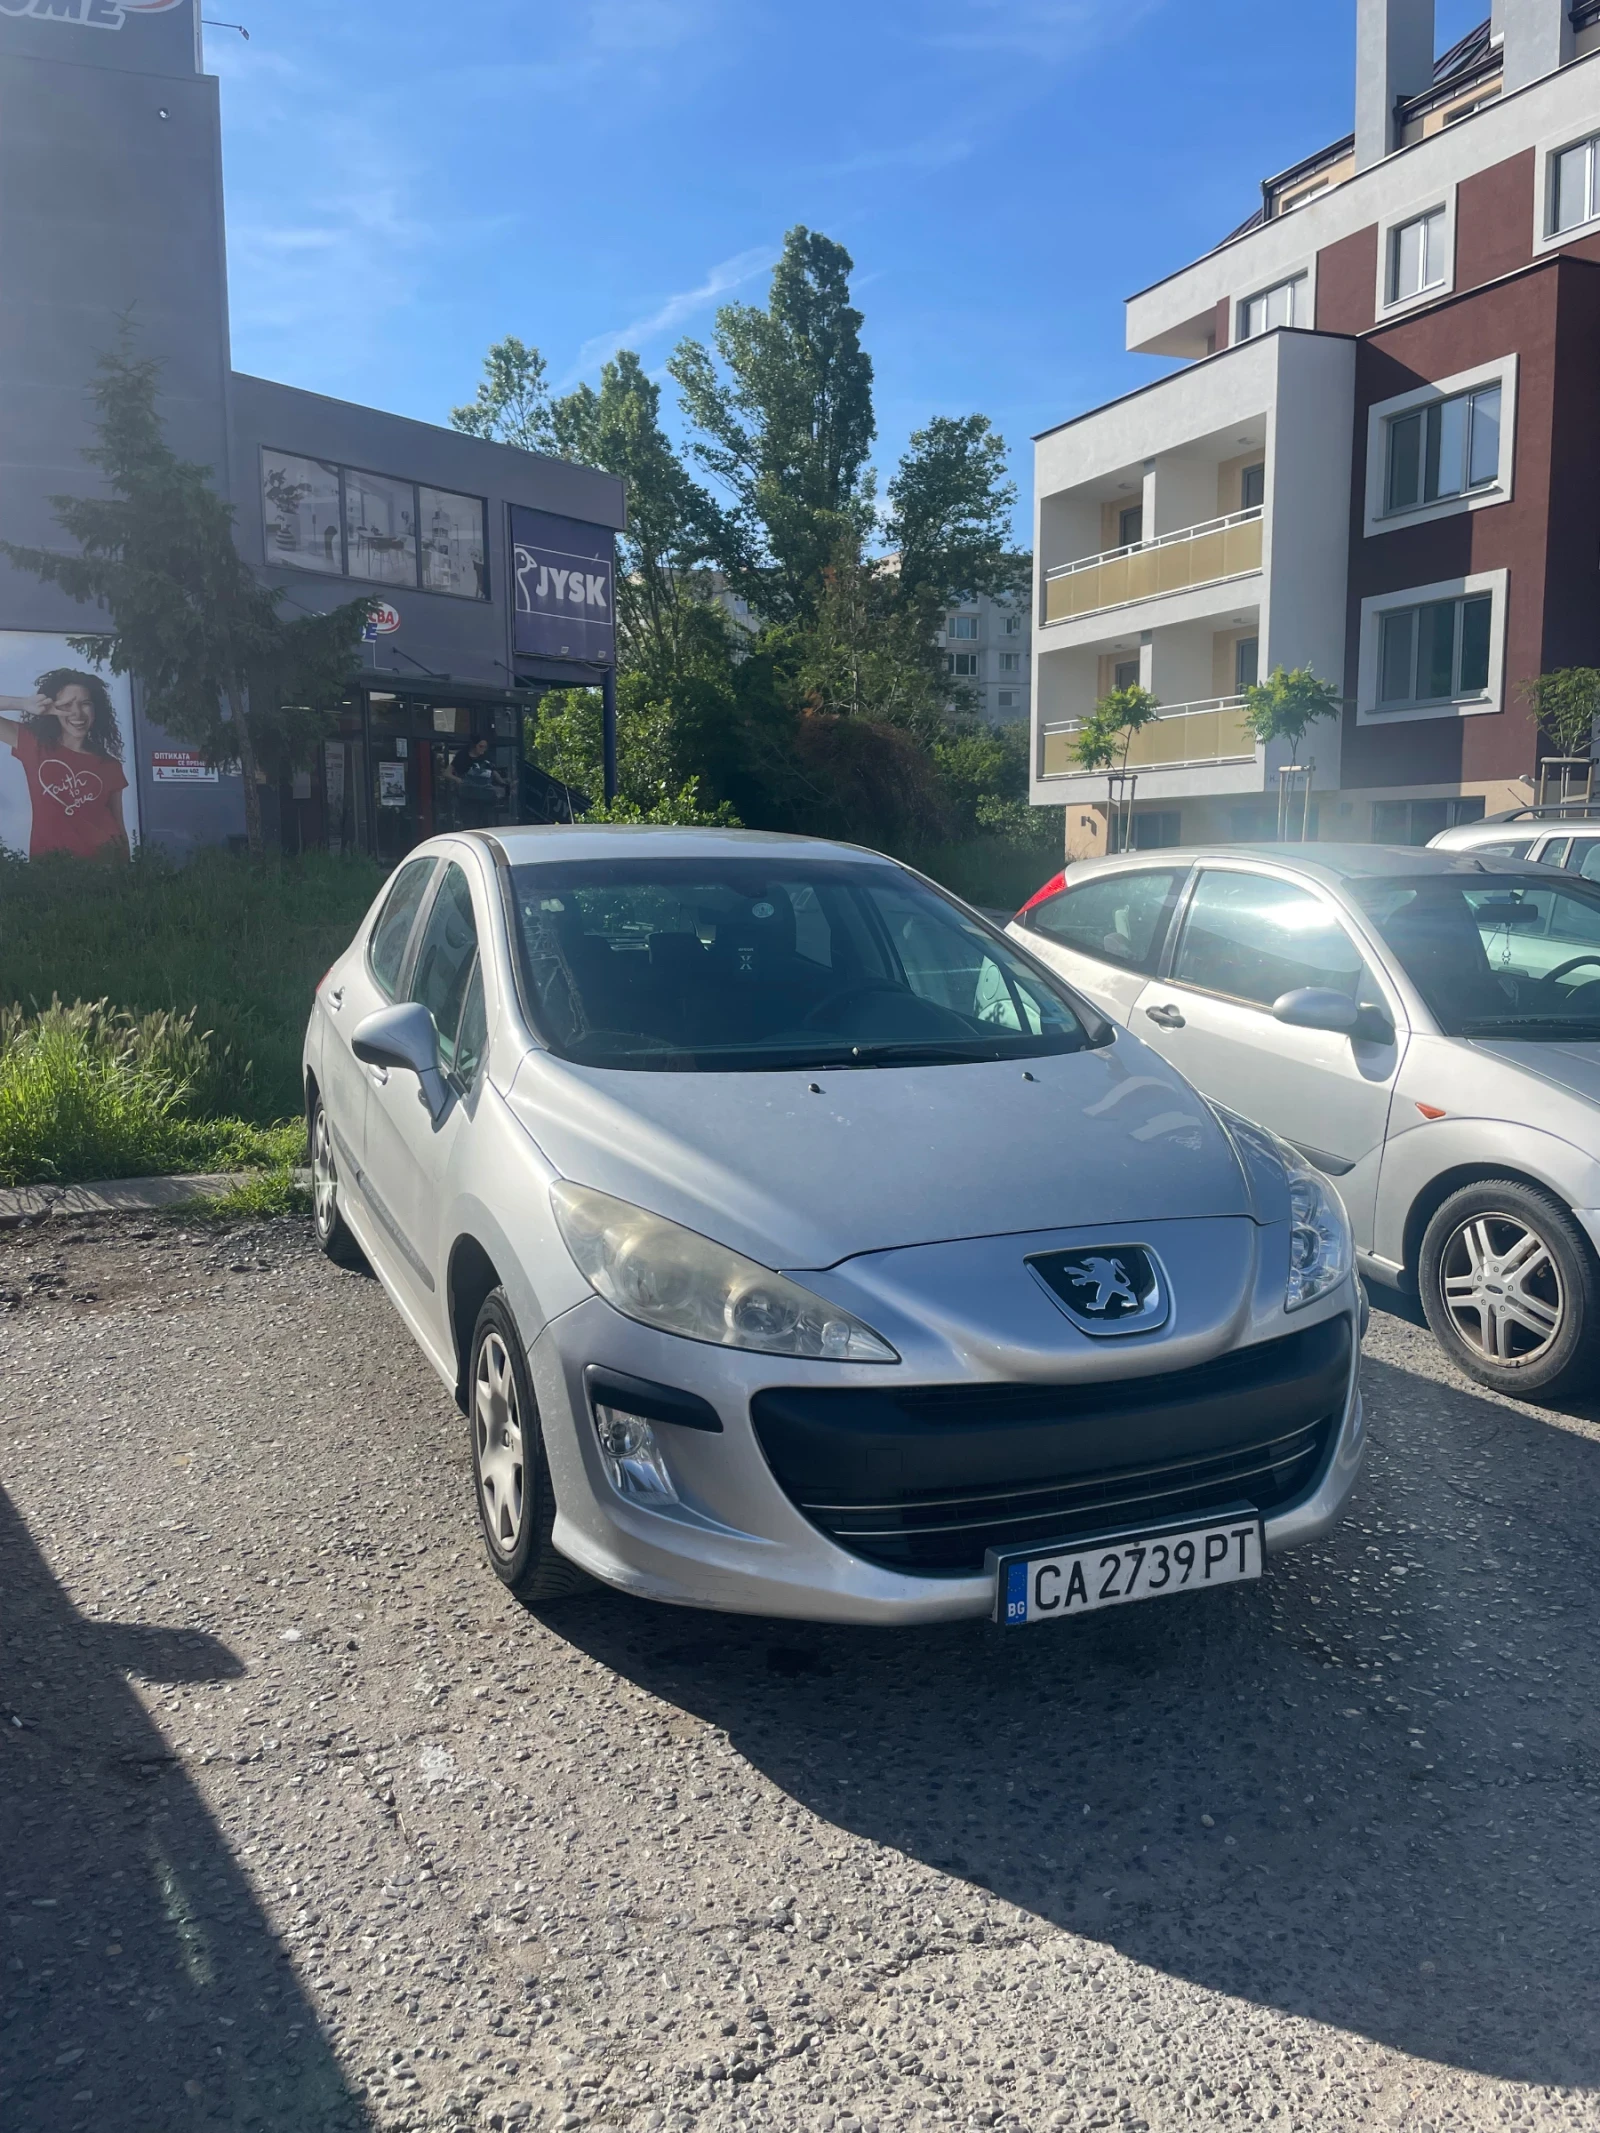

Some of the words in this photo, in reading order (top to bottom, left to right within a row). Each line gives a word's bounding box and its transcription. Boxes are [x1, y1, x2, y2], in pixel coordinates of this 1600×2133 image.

[536, 565, 607, 607] JYSK
[154, 752, 190, 760] ОПТИКАТА
[1008, 1601, 1026, 1617] BG
